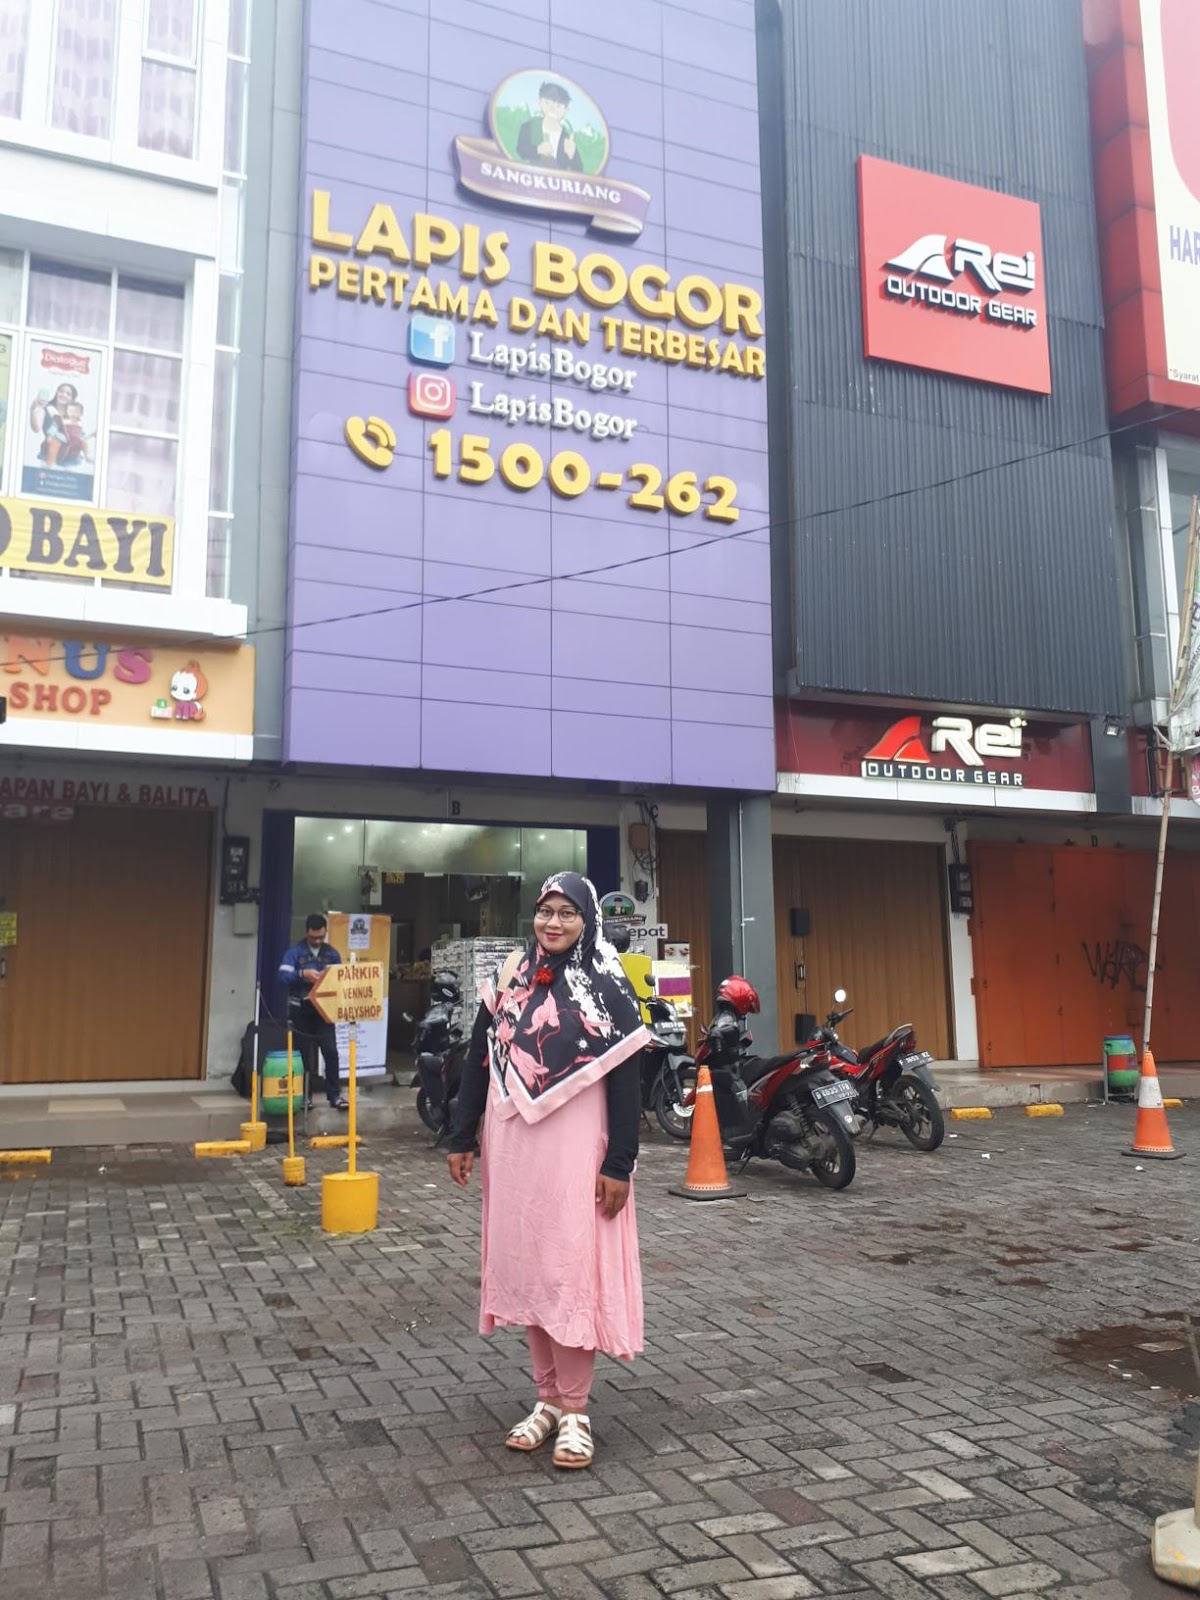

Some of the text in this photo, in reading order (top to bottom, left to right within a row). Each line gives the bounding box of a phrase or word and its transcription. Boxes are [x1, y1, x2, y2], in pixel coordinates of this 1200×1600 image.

[480, 162, 621, 203] SANGKURIANG
[311, 189, 764, 339] LAPIS BOGOR
[953, 238, 1035, 292] Rei
[308, 255, 767, 378] PERTAMA DAN TERBESAR
[886, 275, 1037, 326] OUTDOOR GEAR
[469, 331, 636, 391] LapisBogor
[469, 381, 637, 440] LapisBogor
[428, 429, 739, 522] 1500-262
[26, 507, 168, 577] BAYI
[9, 682, 112, 716] SHOP
[931, 716, 1023, 767] Rei
[62, 780, 110, 802] BAYI
[117, 782, 131, 803] &
[139, 784, 211, 808] BALITA
[868, 763, 1023, 787] OUTDOOR GEAR
[451, 800, 461, 816] B
[628, 926, 666, 939] epat
[337, 966, 380, 981] PARKIR
[343, 985, 373, 1000] VENNUS
[337, 1004, 382, 1021] BABYSHOP
